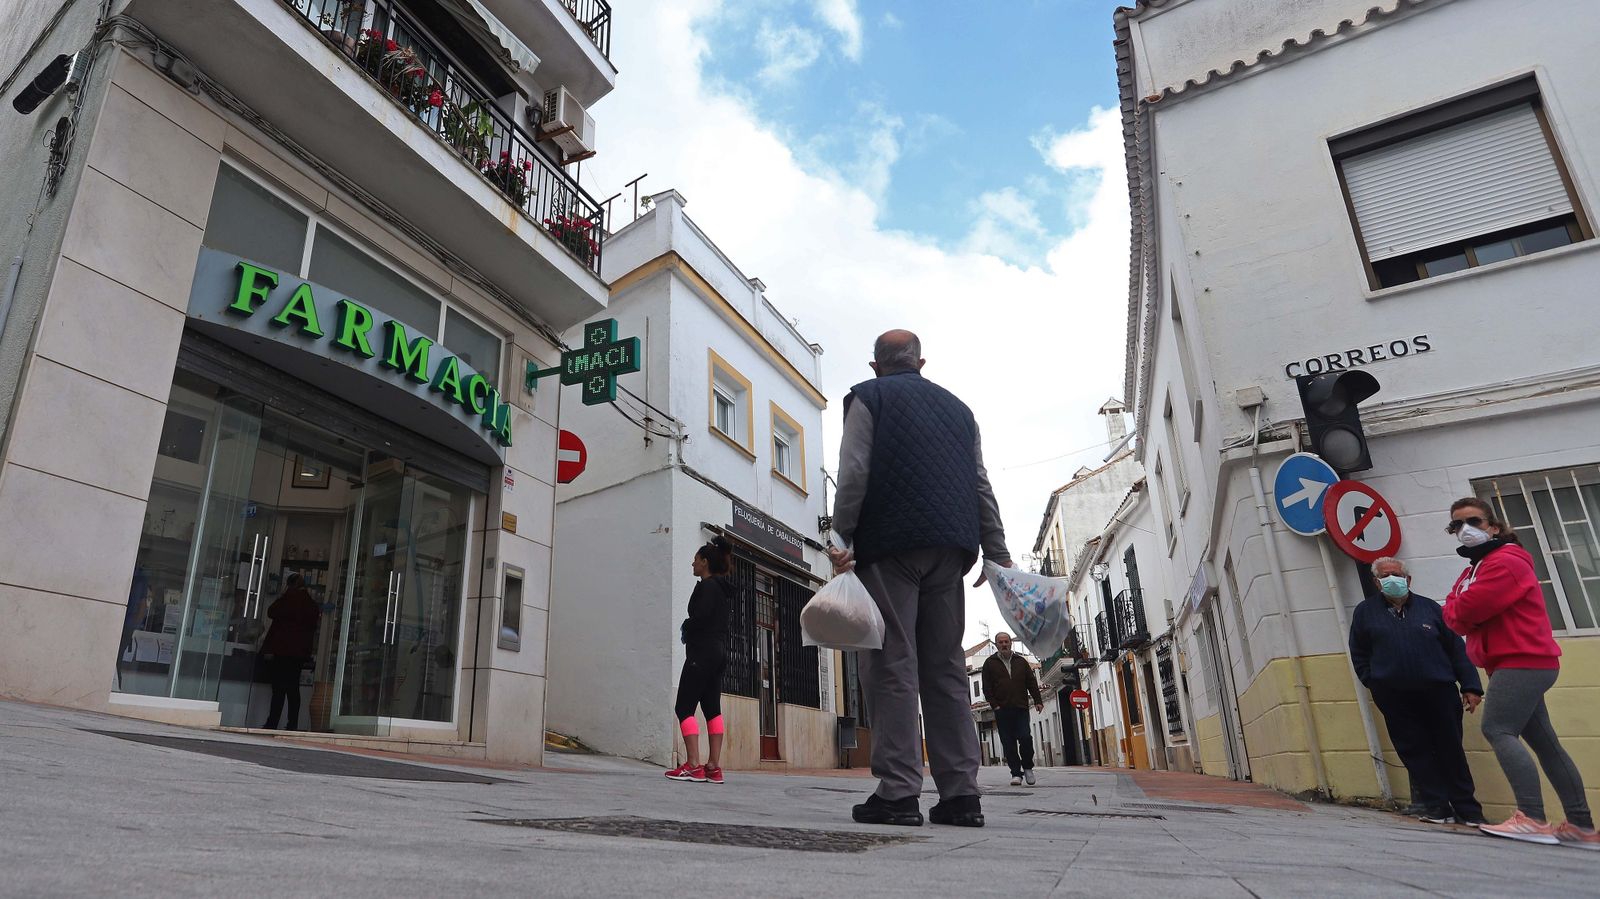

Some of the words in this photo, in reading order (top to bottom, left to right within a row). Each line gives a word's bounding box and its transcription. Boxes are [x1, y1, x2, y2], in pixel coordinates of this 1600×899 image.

[228, 261, 512, 447] FARMACIA
[1285, 335, 1431, 379] CORREOS
[767, 525, 774, 535] DE
[775, 529, 803, 549] CABALLEROS
